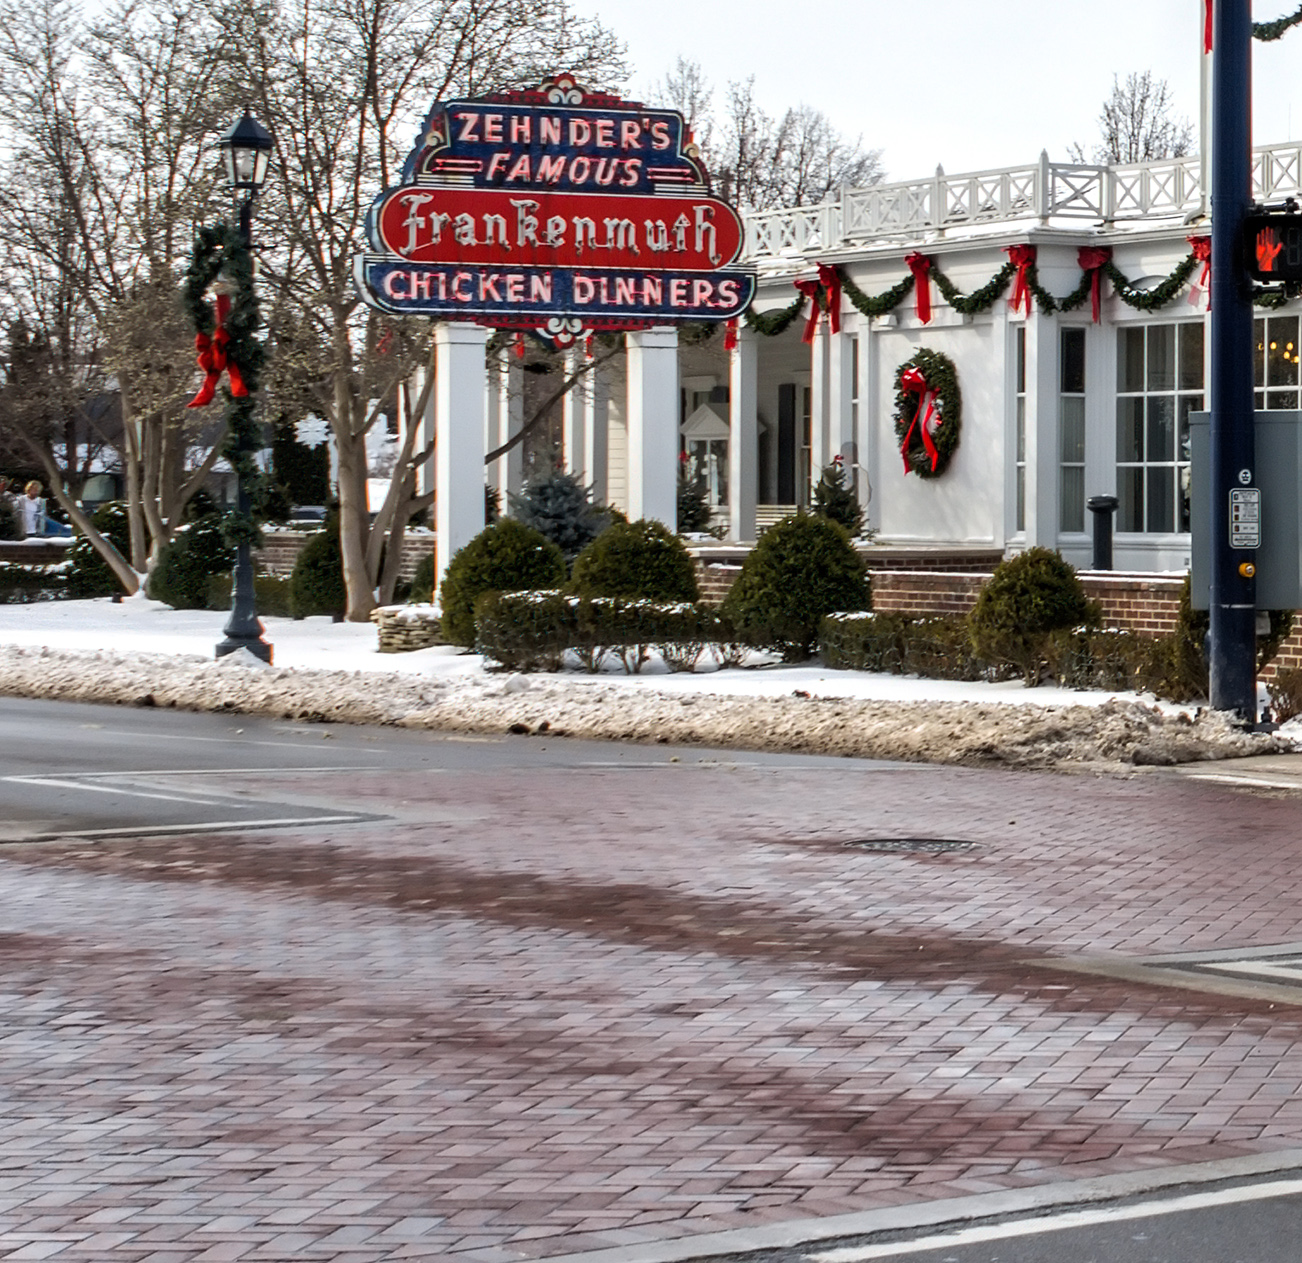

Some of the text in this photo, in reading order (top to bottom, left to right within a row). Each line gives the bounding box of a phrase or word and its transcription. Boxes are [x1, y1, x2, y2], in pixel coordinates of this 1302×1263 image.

[457, 112, 670, 150] ZEHNDER'S
[485, 153, 643, 187] FAMOUS
[399, 192, 722, 266] Frankenmuth
[382, 270, 741, 310] CHICKEN DINNERS
